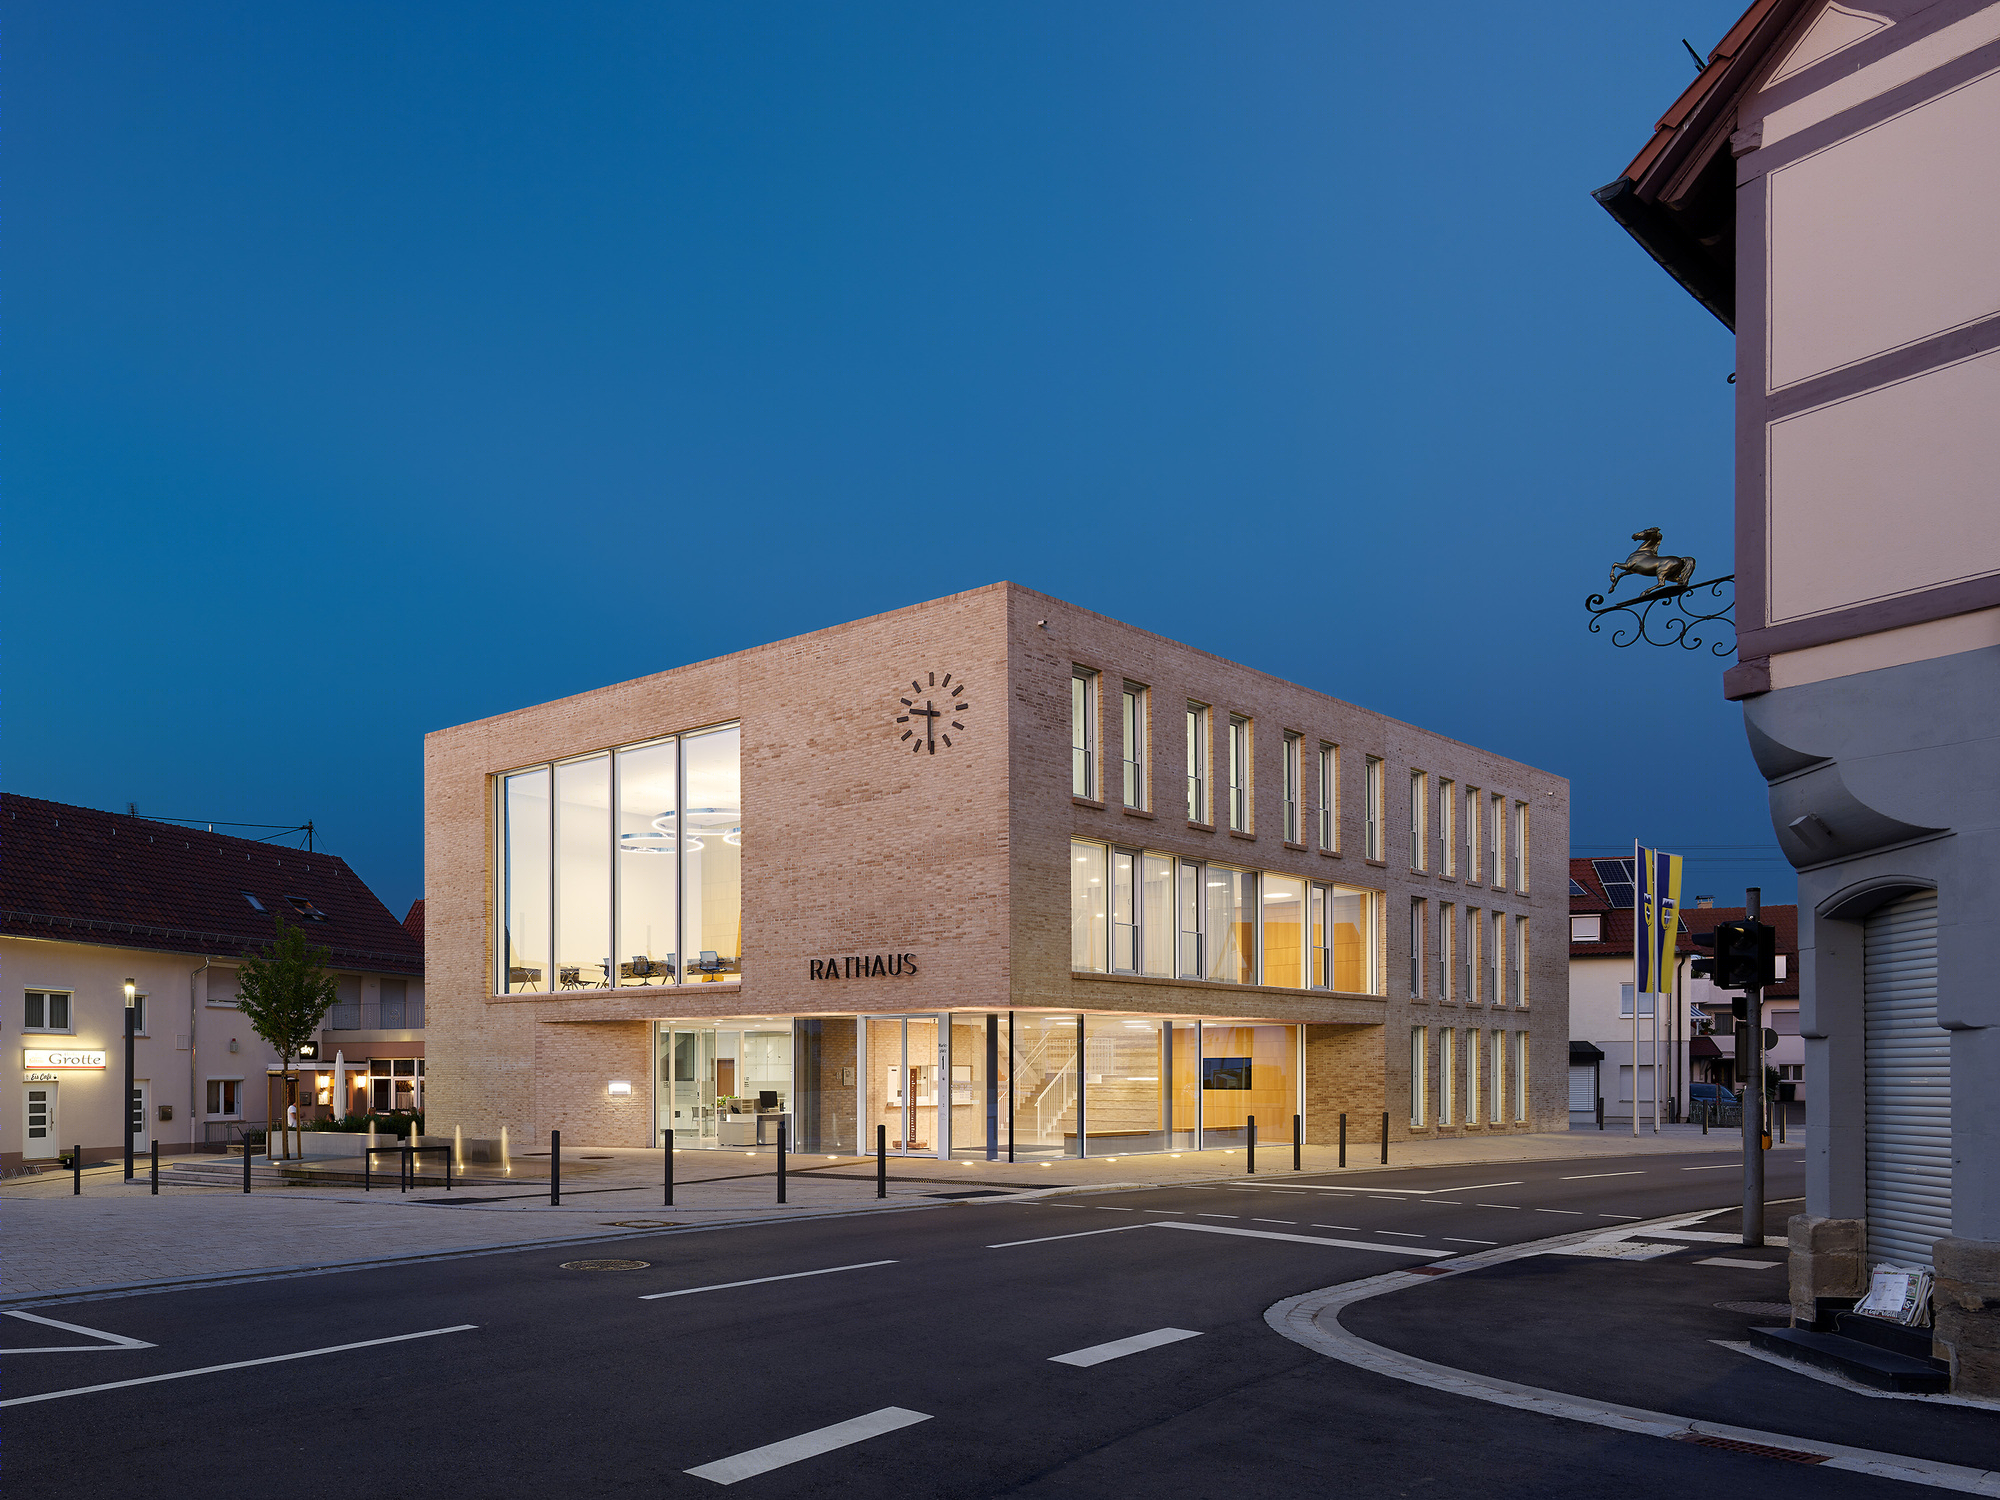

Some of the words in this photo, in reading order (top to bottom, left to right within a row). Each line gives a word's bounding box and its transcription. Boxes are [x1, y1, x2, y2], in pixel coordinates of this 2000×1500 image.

[810, 953, 917, 980] RATHAUS
[300, 1045, 314, 1056] sky
[49, 1053, 101, 1065] Grotte
